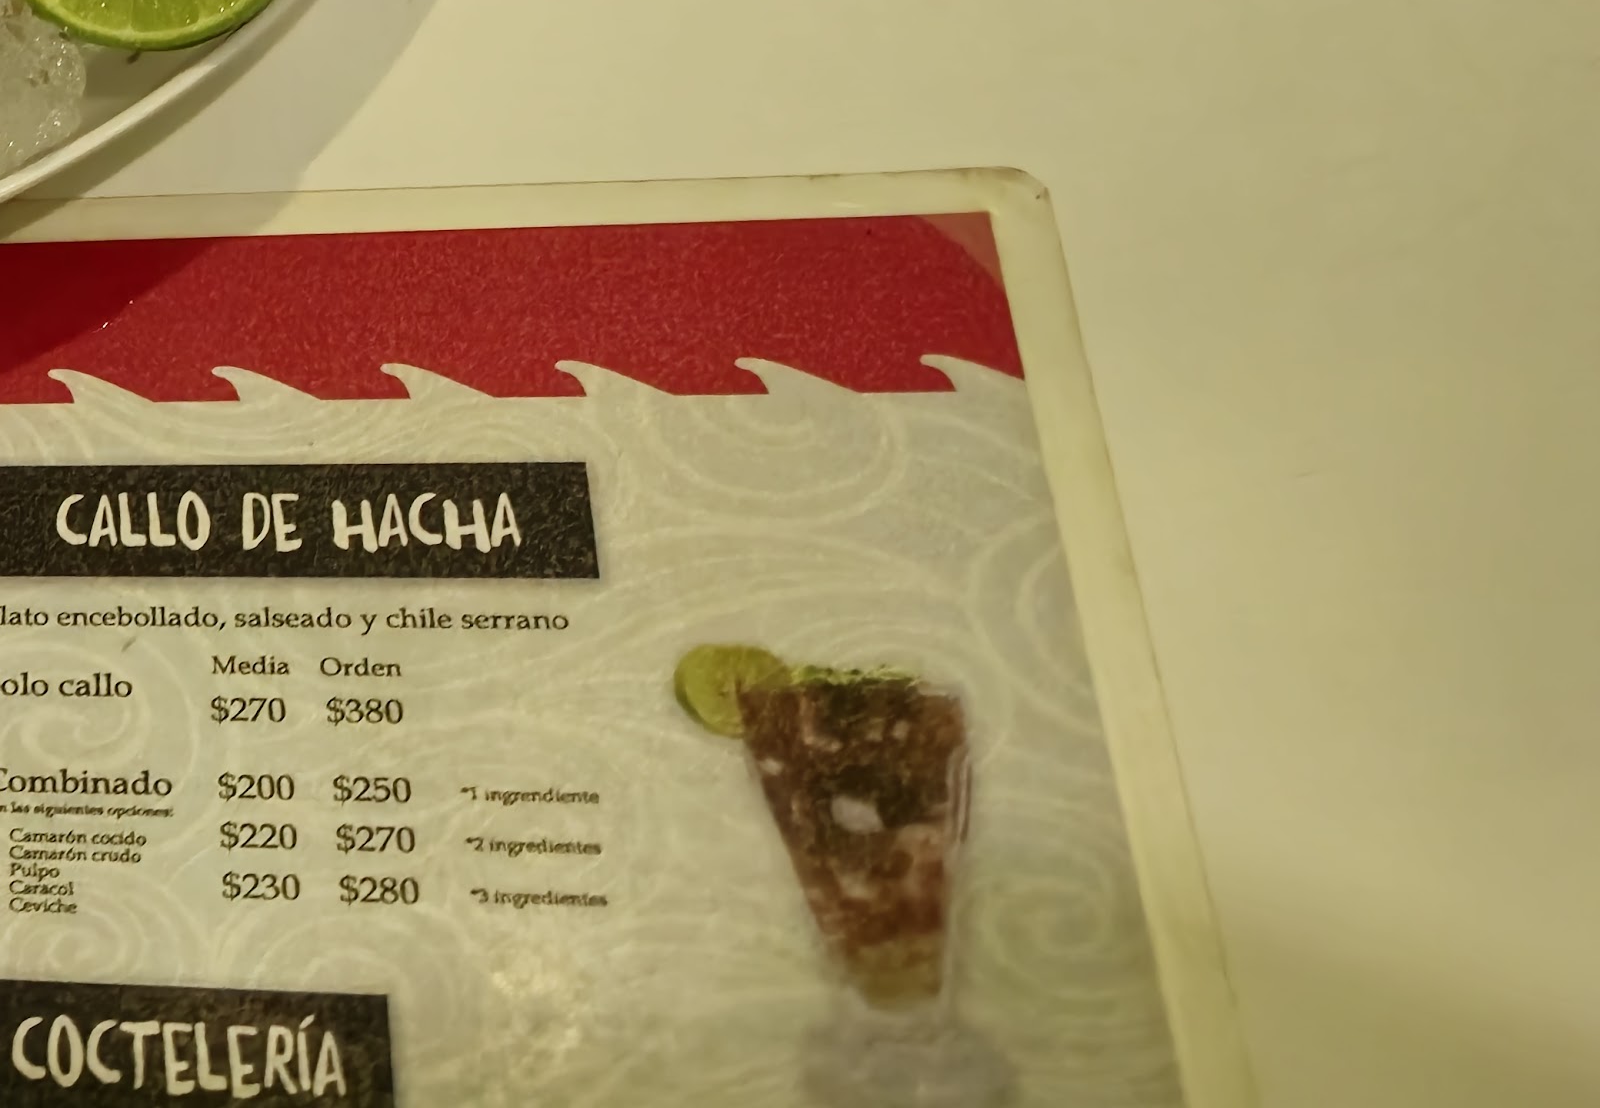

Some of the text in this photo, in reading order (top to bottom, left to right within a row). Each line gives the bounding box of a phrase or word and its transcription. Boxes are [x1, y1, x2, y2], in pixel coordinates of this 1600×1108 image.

[56, 490, 522, 554] CALLO DE HACHA
[57, 605, 227, 632] encebollado,
[234, 607, 353, 629] salseado
[360, 615, 378, 635] y
[386, 607, 453, 631] chile
[460, 612, 570, 632] serrano
[210, 655, 402, 678] Media Orden
[58, 672, 133, 698] callo
[210, 696, 404, 726] $270 $380
[217, 771, 295, 804] $200
[332, 774, 412, 806] $250
[9, 828, 147, 846] Camarón cocido
[220, 821, 297, 854] $220
[335, 822, 416, 854] $270
[9, 845, 142, 863] Camarón crudo
[9, 862, 61, 881] Pulpo
[9, 880, 75, 896] Caracol
[221, 870, 300, 903] $230
[338, 872, 420, 907] $280
[11, 1013, 347, 1099] COCTELERÍA
